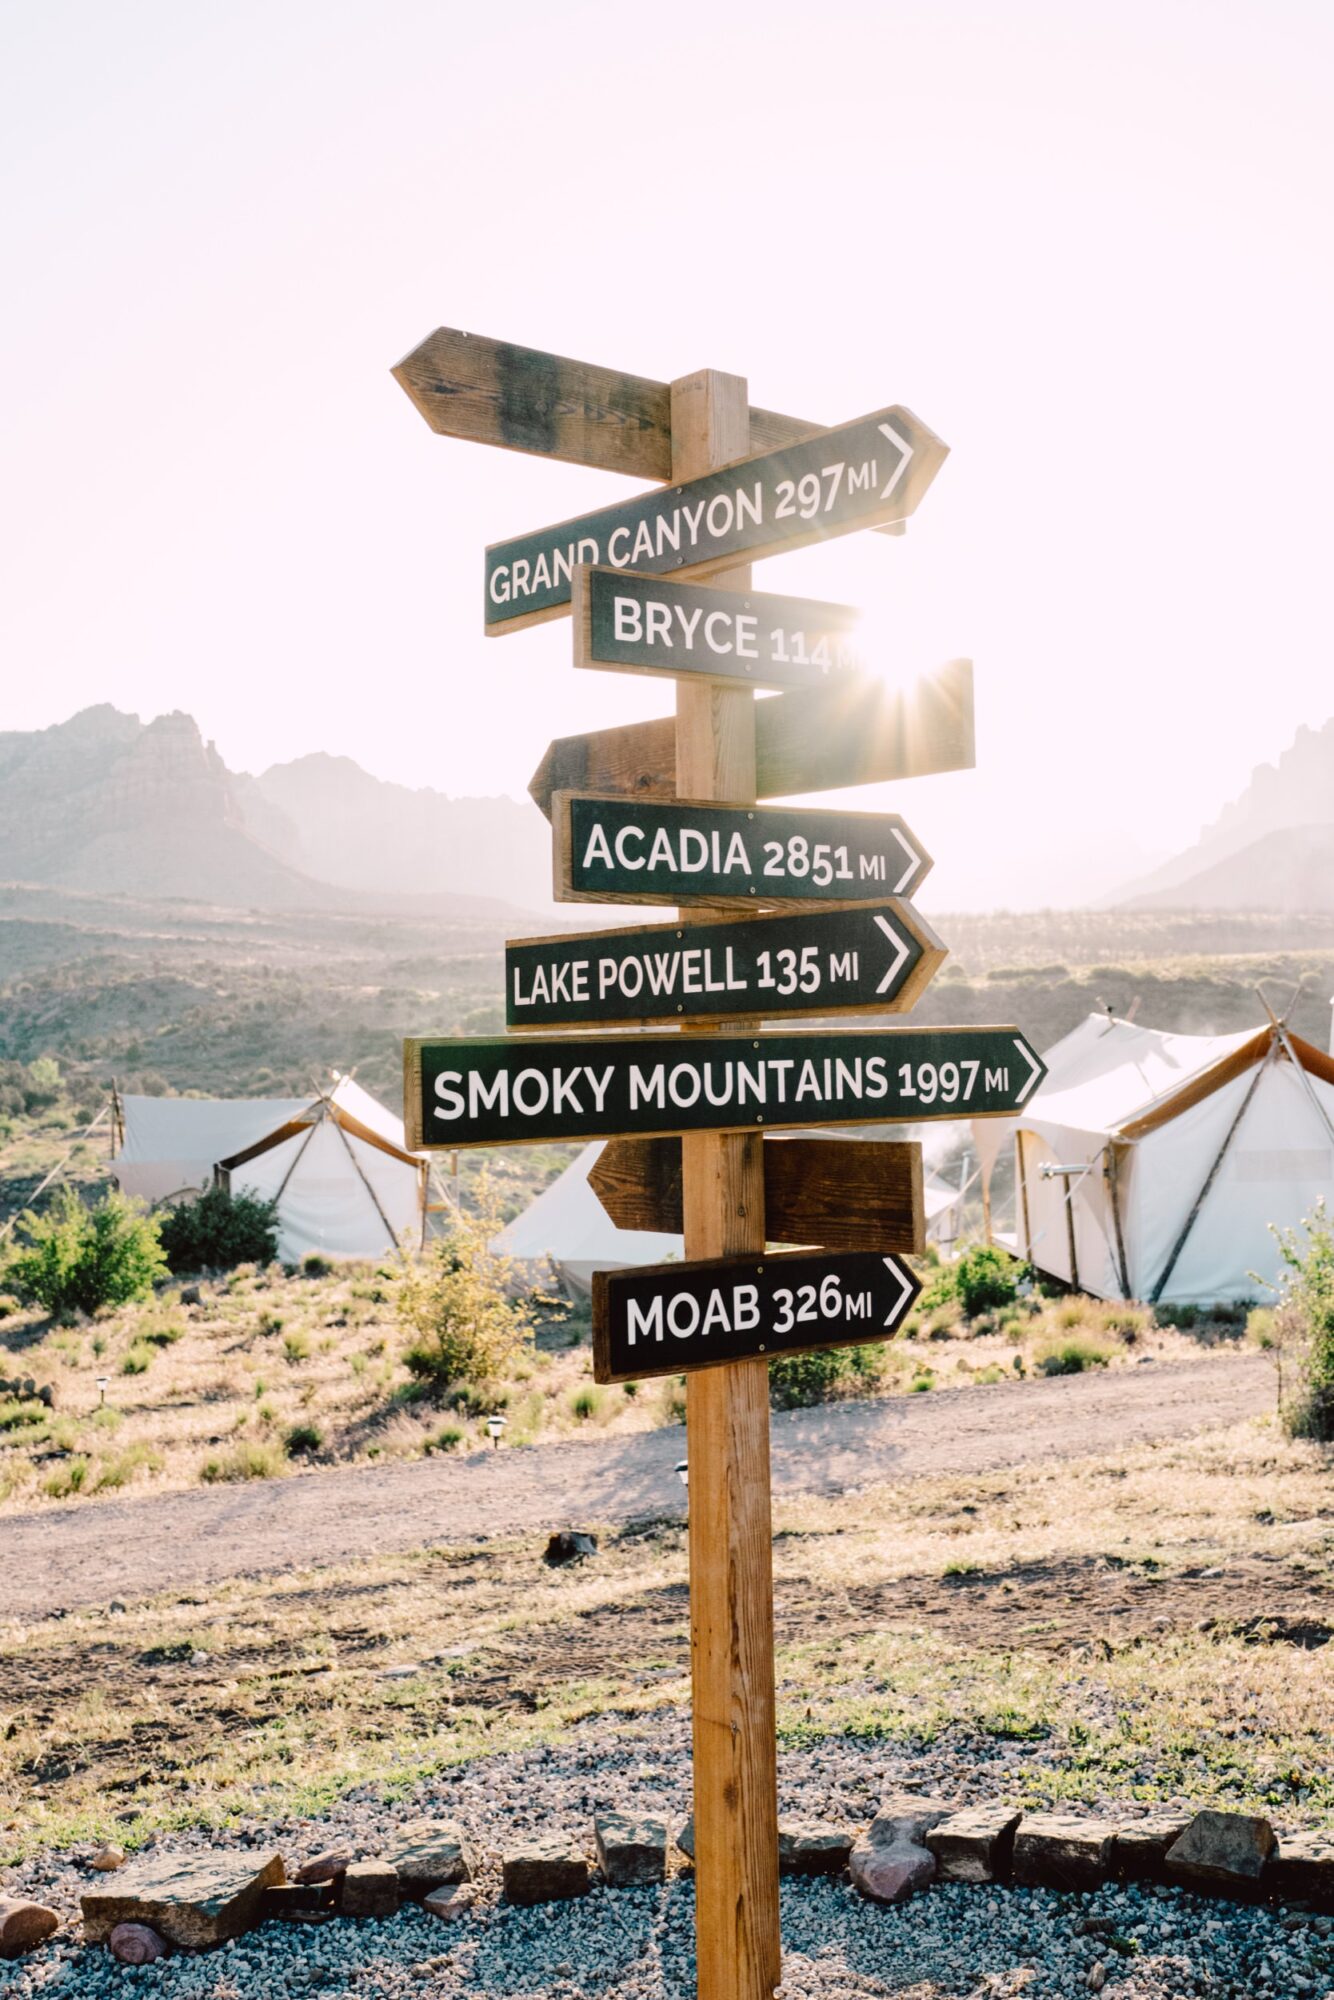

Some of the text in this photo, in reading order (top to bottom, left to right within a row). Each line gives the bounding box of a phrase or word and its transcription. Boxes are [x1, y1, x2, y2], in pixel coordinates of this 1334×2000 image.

[489, 460, 877, 604] GRAND CANYON 297 MI
[614, 596, 863, 674] BRYCE 114 M
[583, 824, 885, 886] ACADIA 2851 MI
[515, 947, 858, 1005] LAKE POWELL 135 MI
[434, 1057, 1008, 1120] SMOKY MOUNTAINS 1997 MI
[627, 1275, 871, 1345] MOAB 326 MI
